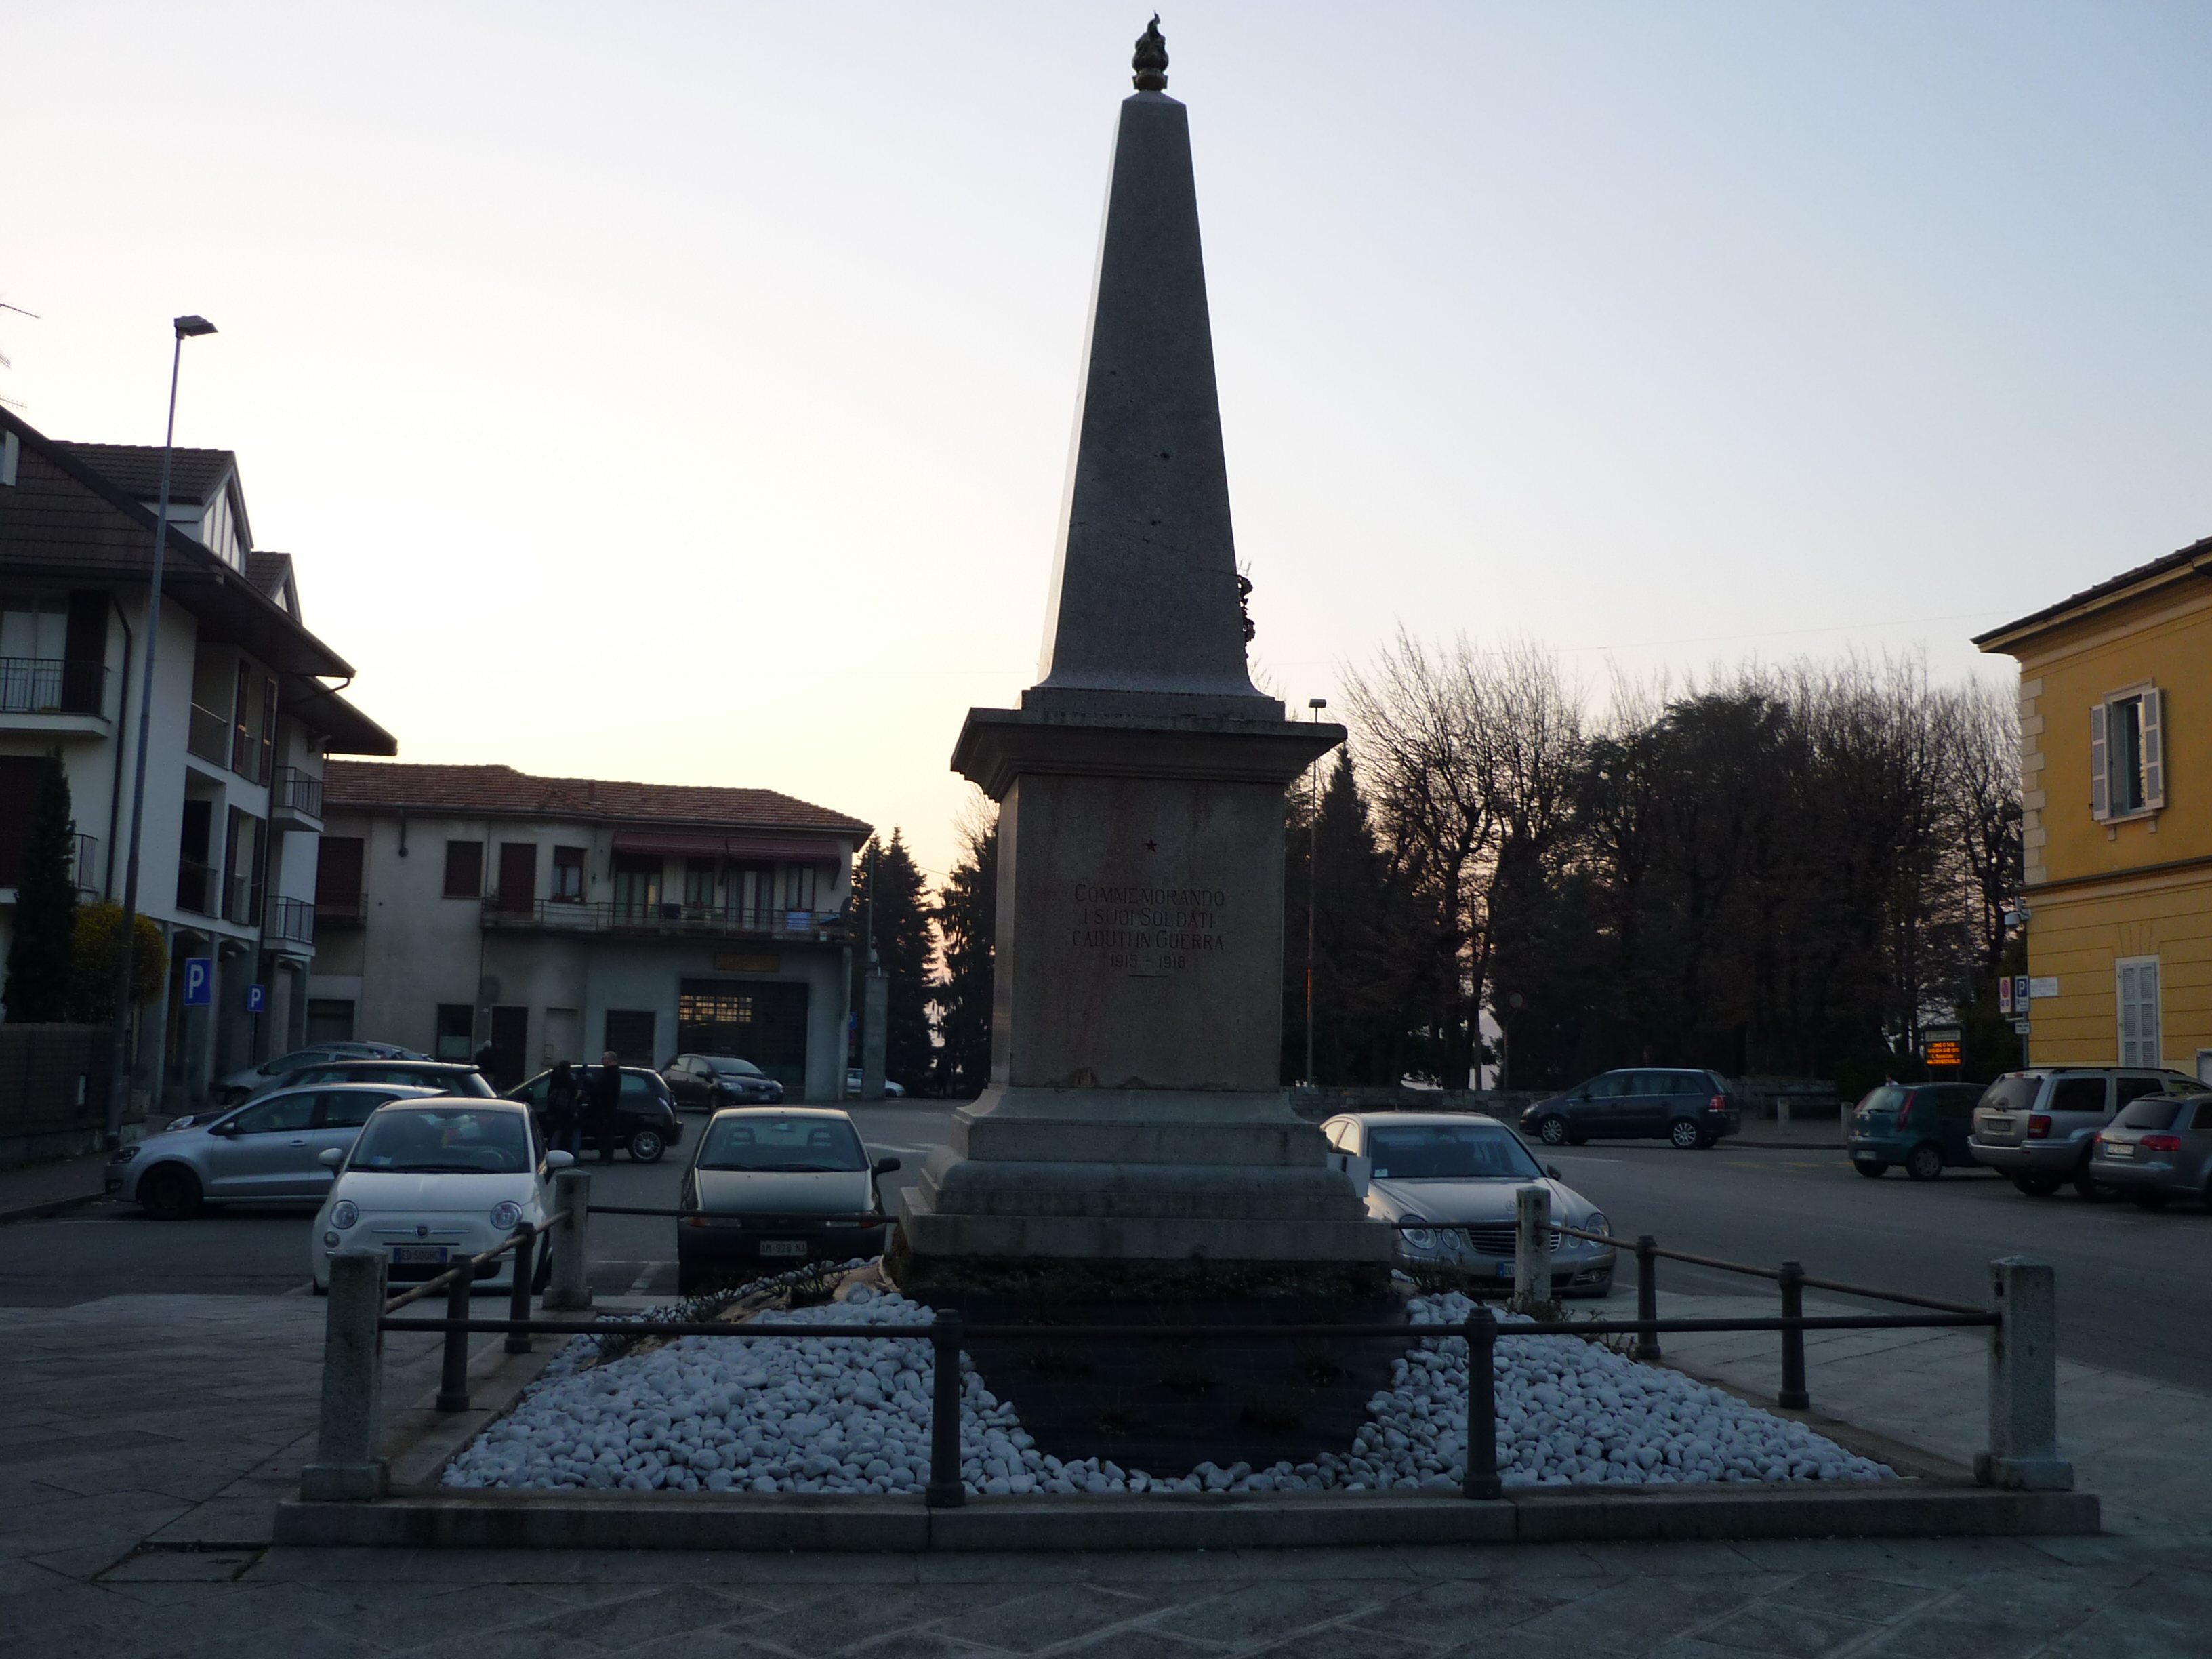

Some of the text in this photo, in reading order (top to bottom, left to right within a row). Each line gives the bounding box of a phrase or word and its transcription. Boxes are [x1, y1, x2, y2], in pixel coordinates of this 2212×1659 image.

[1075, 884, 1225, 906] COMMEMORANDO
[1084, 907, 1213, 928] I SUOI SOLDATI
[1072, 930, 1223, 951] CADUTI IN GUERRA
[1111, 954, 1137, 968] 1915
[1159, 956, 1185, 969] 1918
[188, 964, 204, 999] P
[2018, 981, 2025, 995] P
[251, 988, 261, 1007] P
